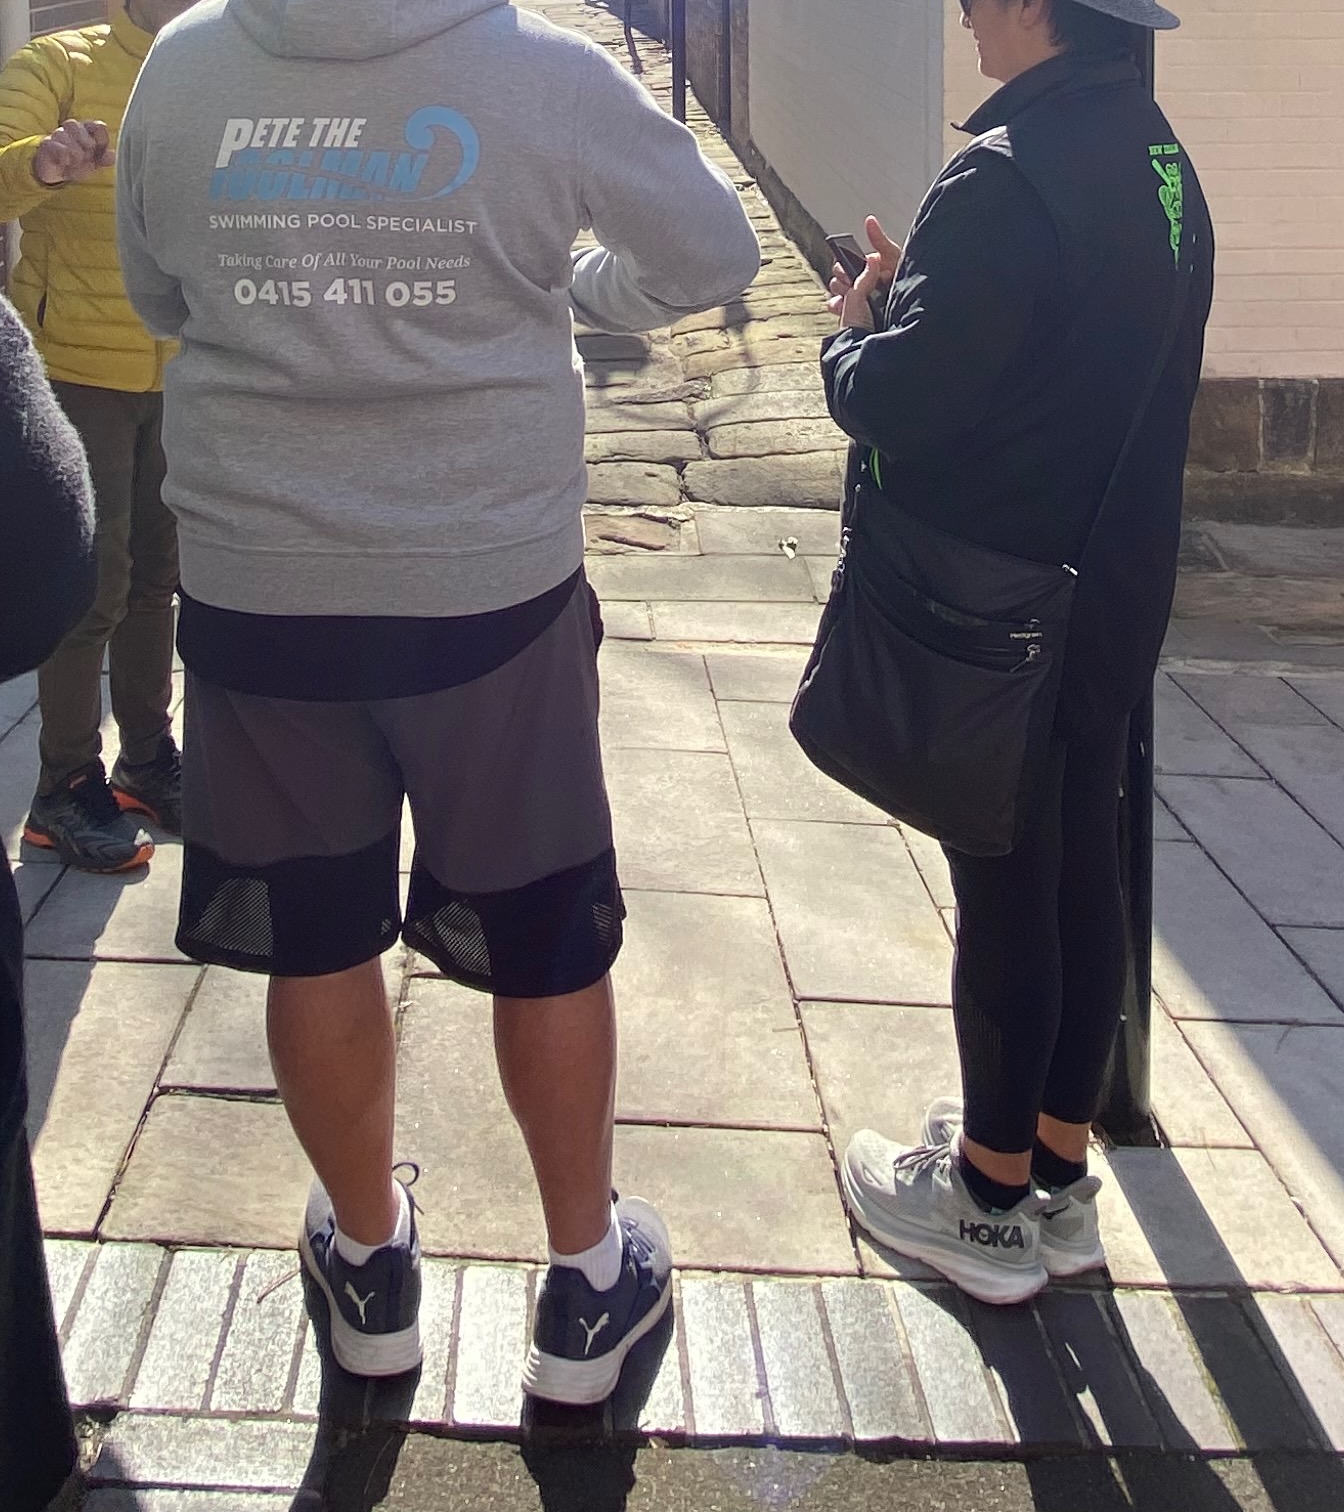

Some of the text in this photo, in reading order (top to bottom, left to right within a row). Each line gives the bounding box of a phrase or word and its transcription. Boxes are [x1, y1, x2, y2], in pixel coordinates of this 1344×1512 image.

[216, 117, 367, 168] PETE THE
[209, 214, 478, 235] SWIMMING POOL SPECIALIST
[218, 252, 471, 271] Taking Care Of All Your Pool Needs
[234, 278, 456, 307] 0415 411 055
[959, 1219, 1024, 1249] HOKA
